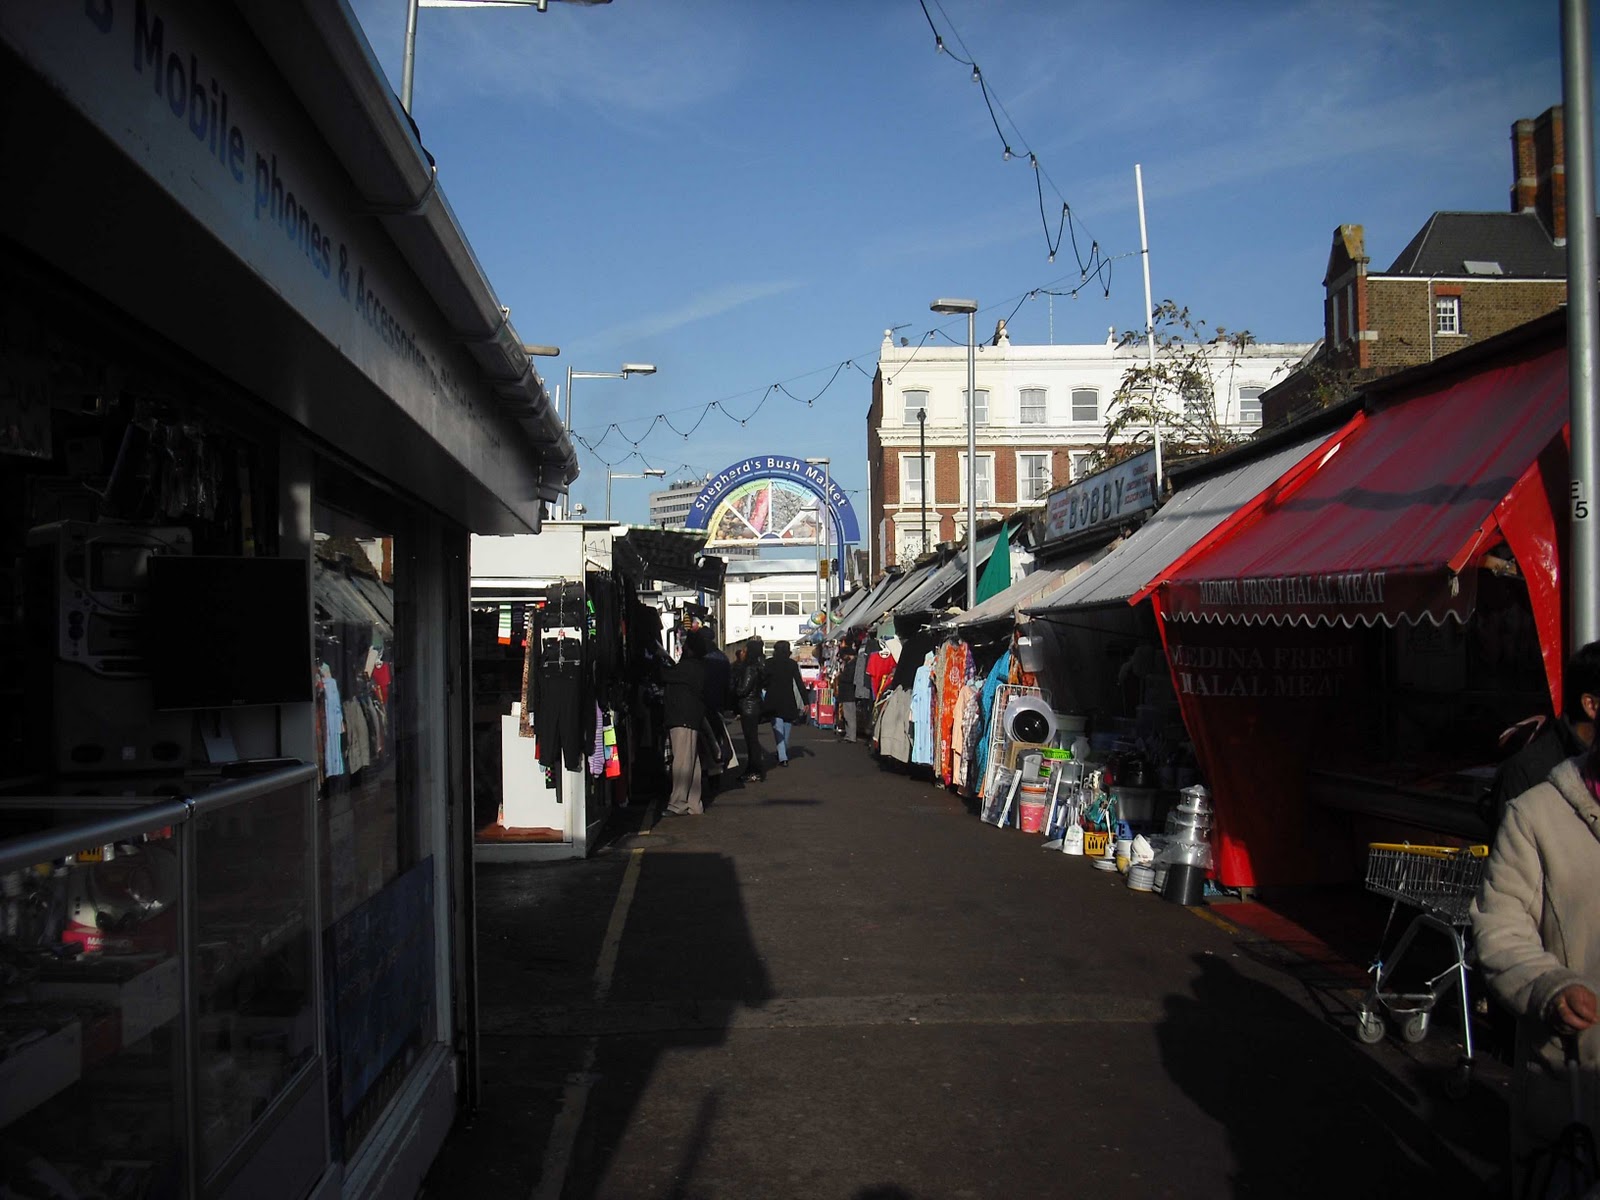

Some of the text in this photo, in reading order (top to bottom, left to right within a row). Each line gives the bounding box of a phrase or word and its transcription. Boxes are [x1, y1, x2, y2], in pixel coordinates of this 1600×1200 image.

[134, 0, 245, 184] Mobile
[254, 152, 331, 280] phones
[338, 243, 350, 299] &
[695, 459, 762, 511] Shepherd's
[767, 457, 801, 472] Bush
[1069, 476, 1125, 529] BOBBY
[1575, 501, 1588, 518] 5
[1199, 571, 1386, 606] MEDINA FRESH HALAL MEAT
